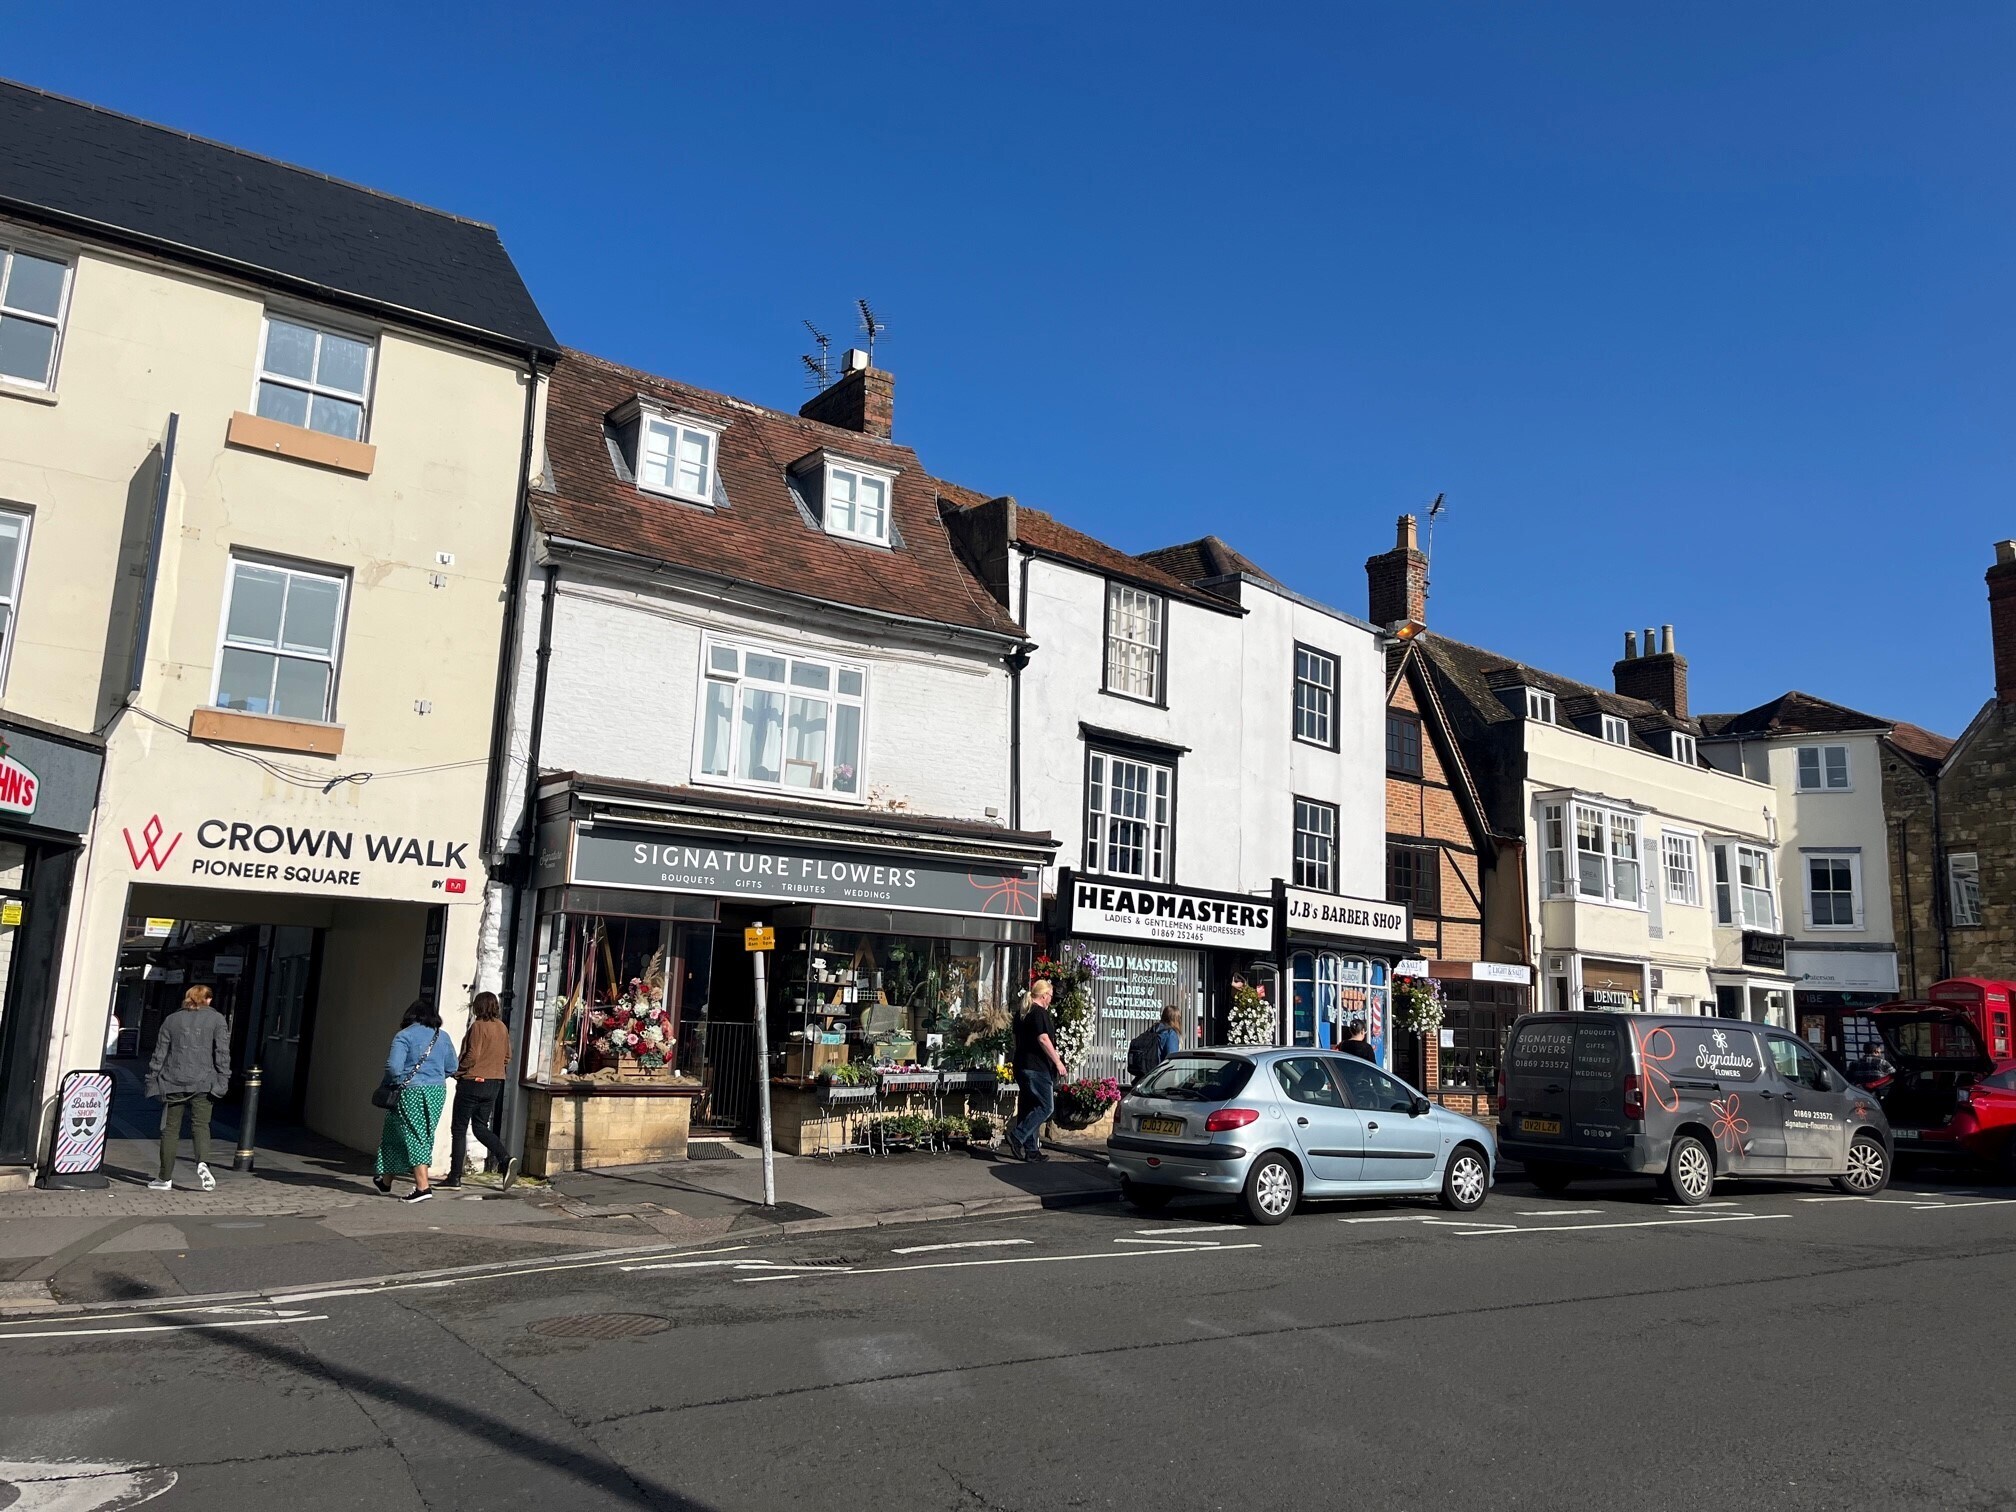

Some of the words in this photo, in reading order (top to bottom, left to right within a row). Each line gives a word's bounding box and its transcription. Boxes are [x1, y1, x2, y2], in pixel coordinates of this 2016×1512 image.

[197, 819, 353, 860] CROWN
[365, 834, 469, 869] WALK
[633, 843, 790, 876] SIGNATURE
[801, 859, 916, 888] FLOWERS
[192, 859, 279, 880] PIONEER
[284, 866, 361, 886] SQUARE
[432, 879, 444, 889] BY
[661, 873, 715, 885] BOUQUETS
[735, 879, 763, 889] GIFTS
[781, 883, 826, 894] TRIBUTES
[843, 888, 891, 900] WEDDINGS
[1077, 885, 1269, 929] HEADMASTERS
[1289, 900, 1318, 920] J.B's
[1321, 905, 1370, 927] BARBER
[1372, 912, 1402, 930] SHOP
[1104, 913, 1132, 924] LADIES
[1135, 917, 1141, 925] &
[1144, 918, 1193, 931] GENTLEMENS
[1196, 924, 1246, 937] HAIRDRESSERS
[1151, 928, 1175, 938] 01869
[1177, 930, 1204, 942] 252465
[1126, 956, 1178, 974] MASTERS
[1131, 973, 1177, 986] Rosaleen's
[1115, 984, 1146, 996] LADIES
[1147, 986, 1155, 996] &
[1593, 989, 1630, 1004] IDENTITY
[1106, 996, 1163, 1009] GENTLEMENS
[1102, 1008, 1162, 1021] HAIRDRESSER
[1110, 1028, 1126, 1039] EAR
[1519, 1034, 1573, 1044] SIGNATURE
[1521, 1045, 1566, 1055] FLOWERS
[1515, 1059, 1538, 1068] 01869
[1540, 1061, 1569, 1069] 253572
[1578, 1056, 1611, 1064] TRIBUTES
[1695, 1044, 1754, 1071] Signature
[1575, 1070, 1612, 1078] WEDDINGS
[1714, 1069, 1741, 1078] FLOWERS
[71, 1097, 102, 1109] Barber
[77, 1109, 95, 1117] SHOP
[1793, 1109, 1812, 1119] 01869
[1812, 1111, 1833, 1121] 253572
[1542, 1123, 1558, 1133] LZK
